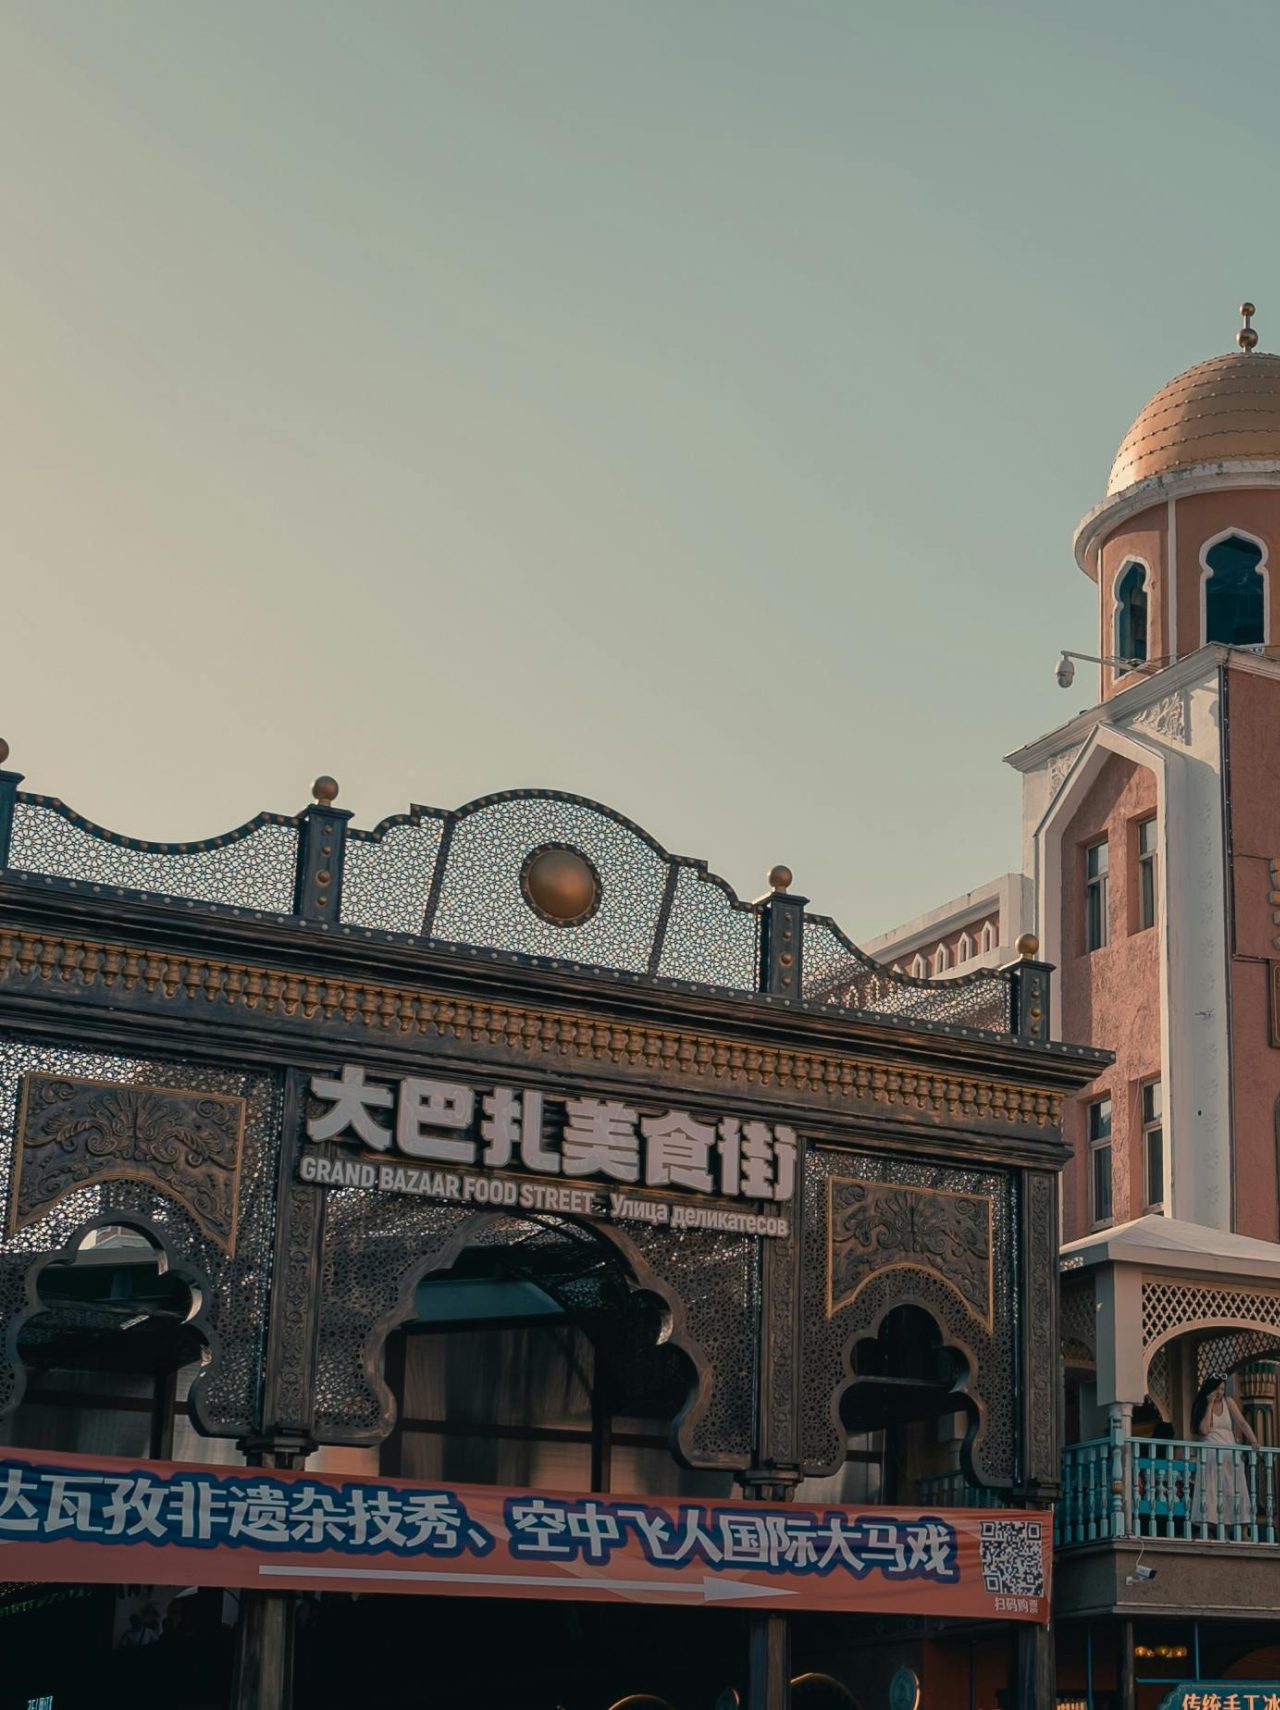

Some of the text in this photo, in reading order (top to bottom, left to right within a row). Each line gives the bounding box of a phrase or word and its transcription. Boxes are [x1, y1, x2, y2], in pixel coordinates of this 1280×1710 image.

[306, 1063, 798, 1200] 大巴扎美食街
[301, 1156, 594, 1214] GRAND BAZAAR FOOD STREET
[610, 1193, 791, 1237] Улица деликатесов
[994, 1597, 1038, 1614] 扫码购票
